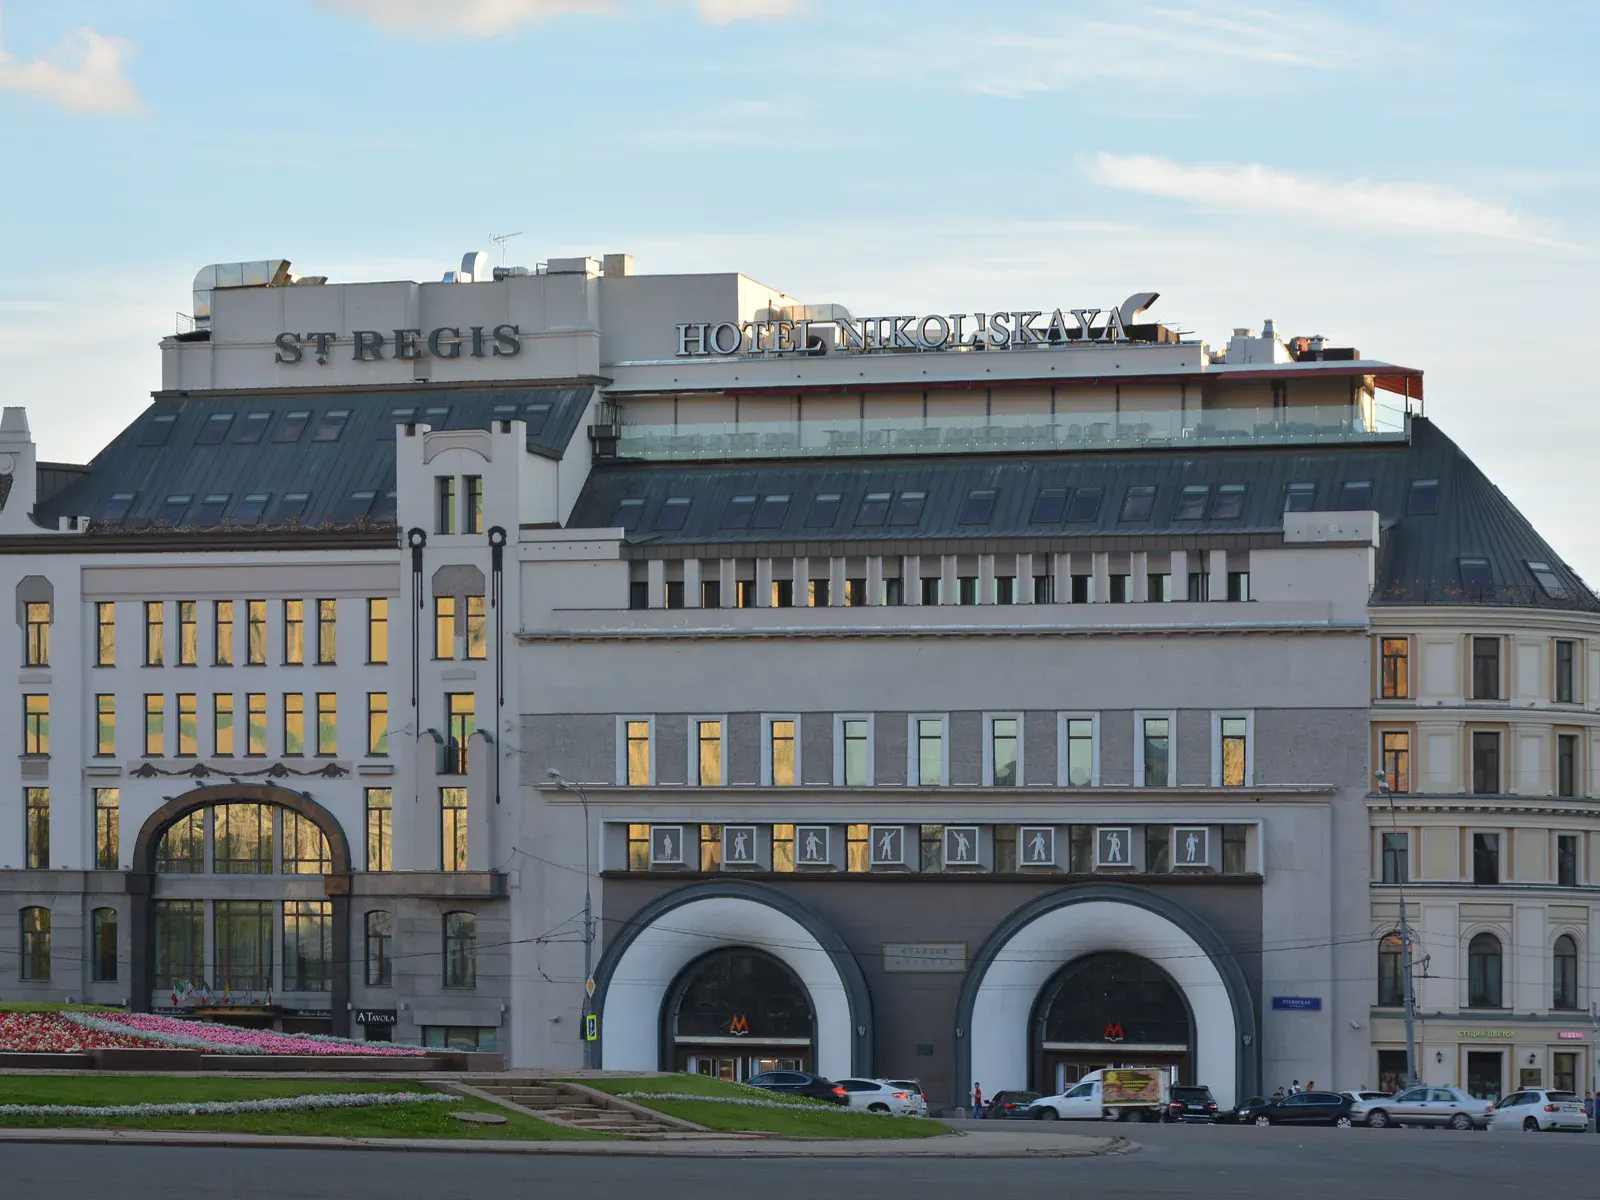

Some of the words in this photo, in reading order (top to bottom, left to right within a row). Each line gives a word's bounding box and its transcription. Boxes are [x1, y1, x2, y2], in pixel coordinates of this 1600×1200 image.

[351, 324, 521, 361] REGIS
[675, 319, 823, 356] HOTEL
[834, 306, 1130, 351] NIKOL'SKAYA
[357, 1012, 365, 1022] A
